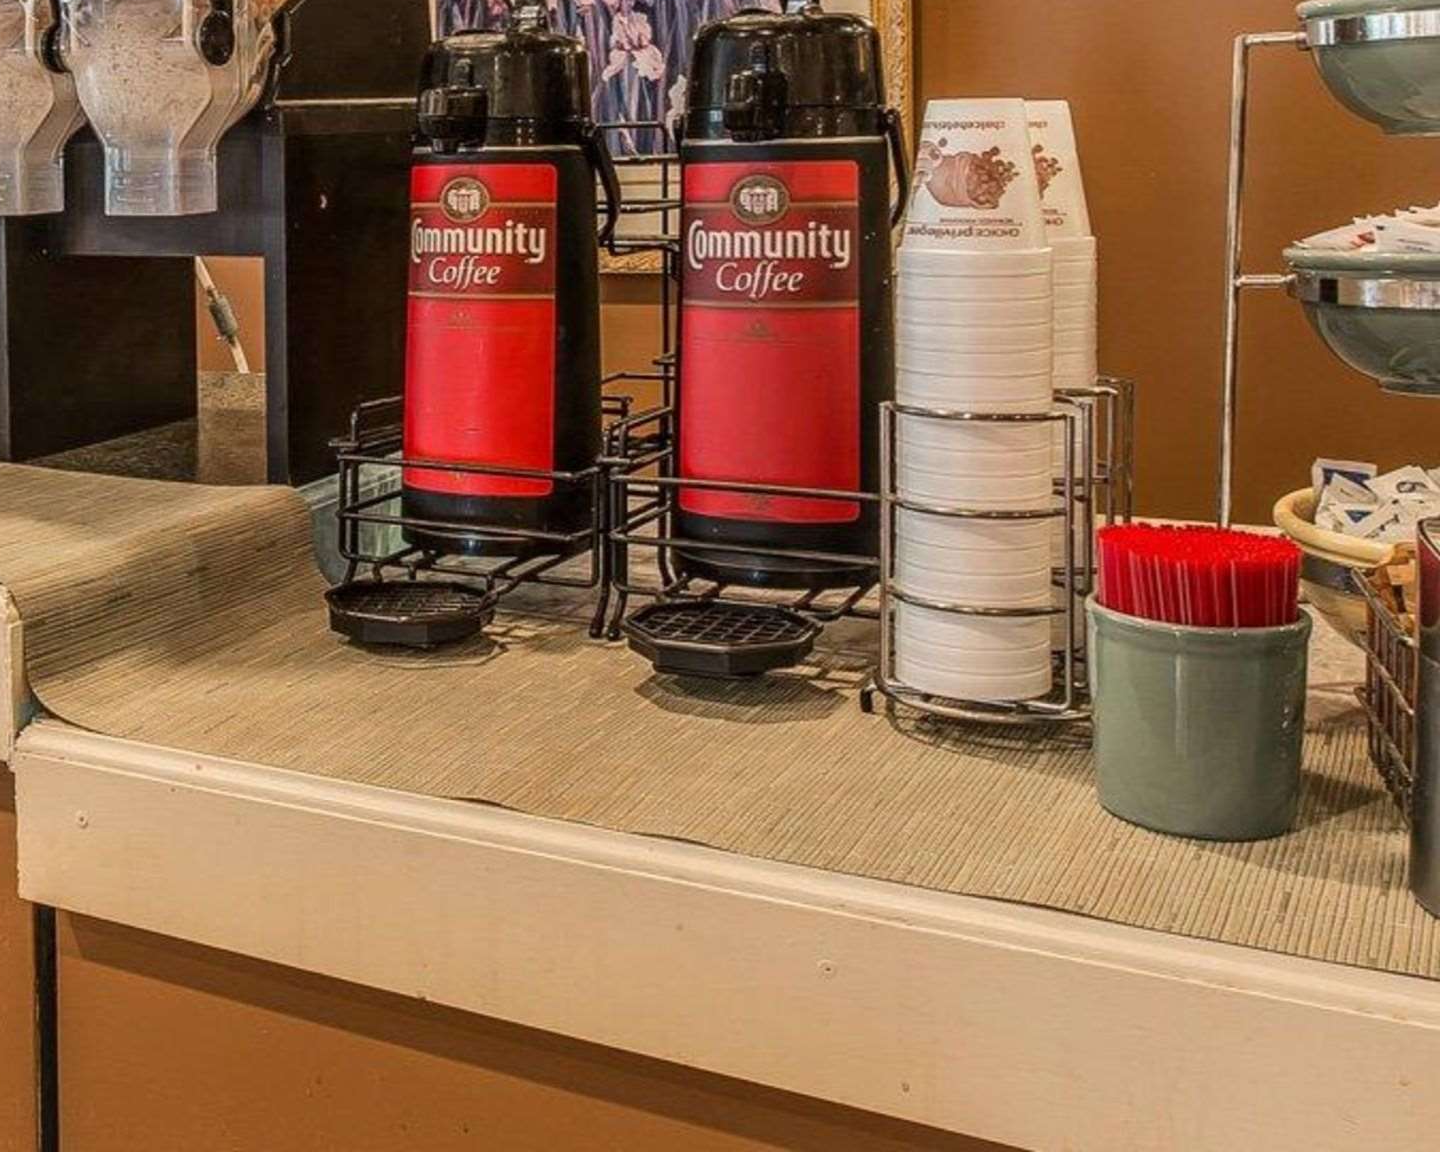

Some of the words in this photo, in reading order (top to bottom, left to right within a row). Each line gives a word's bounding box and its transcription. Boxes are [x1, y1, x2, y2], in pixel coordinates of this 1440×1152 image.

[411, 217, 547, 264] Community
[687, 219, 851, 271] Community
[428, 254, 502, 290] Coffee
[715, 259, 805, 299] Coffee
